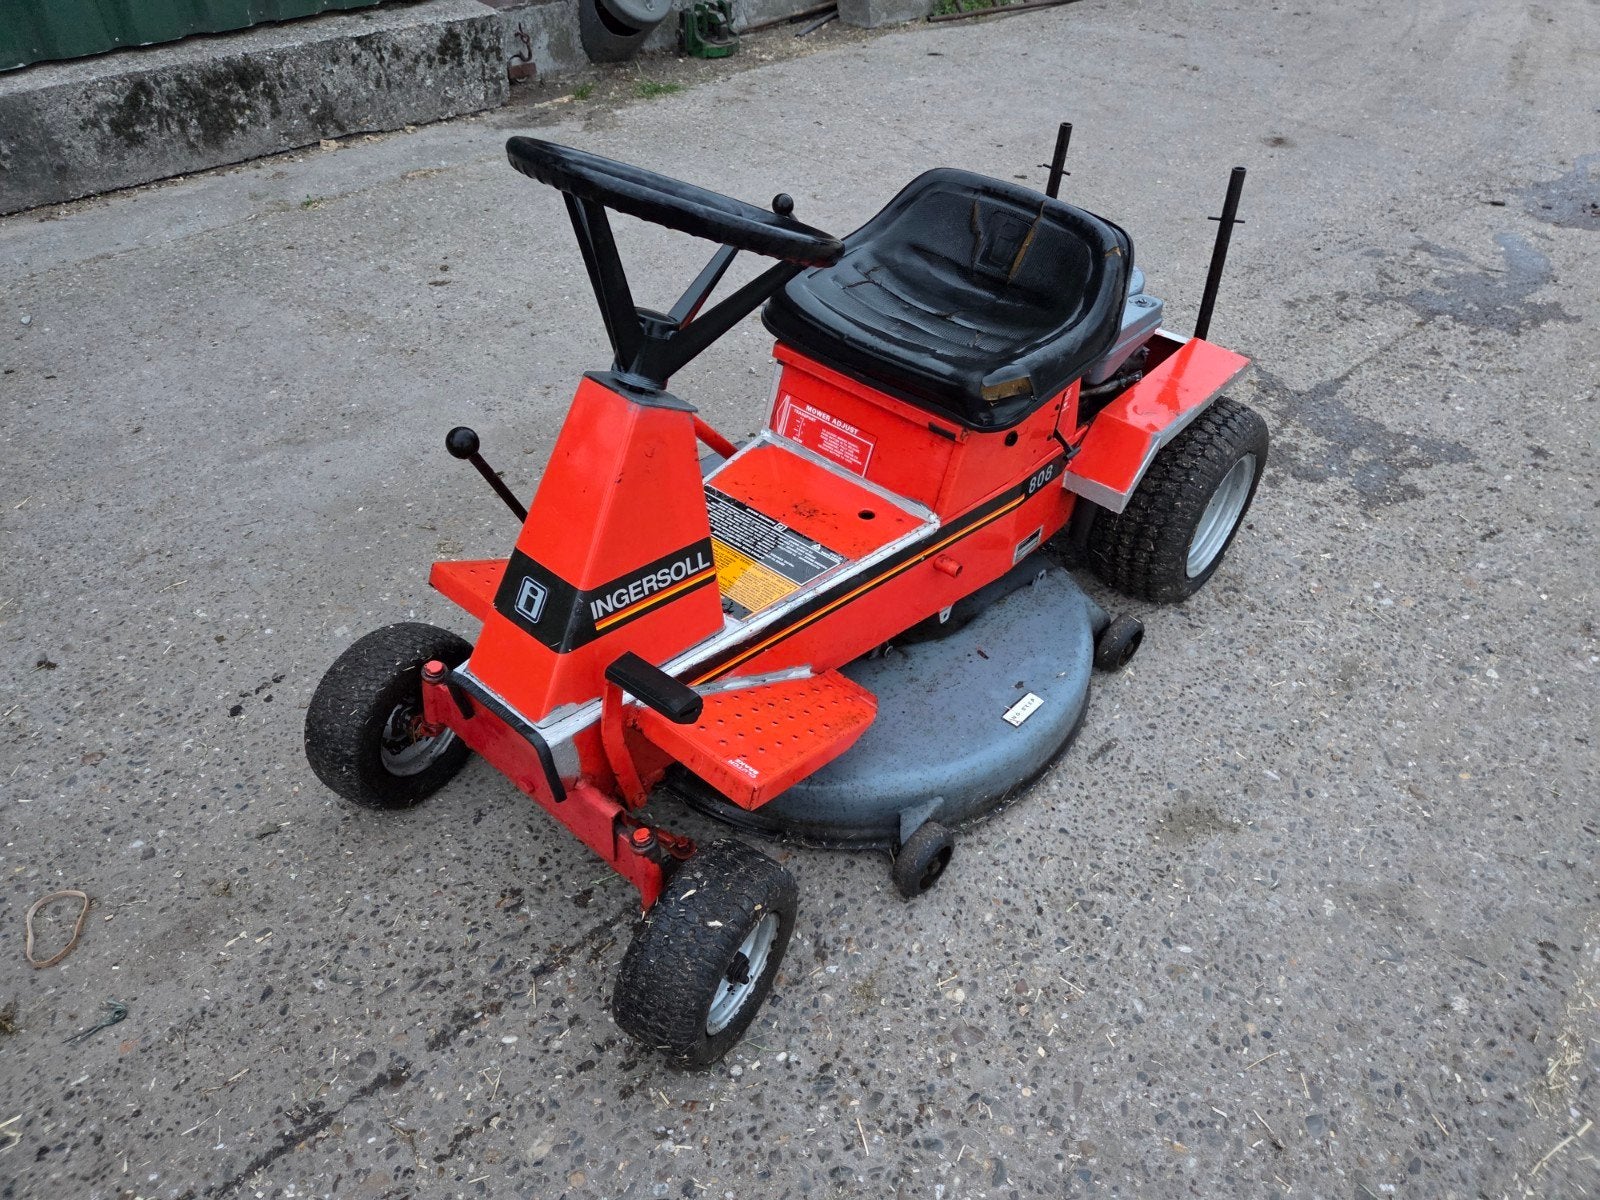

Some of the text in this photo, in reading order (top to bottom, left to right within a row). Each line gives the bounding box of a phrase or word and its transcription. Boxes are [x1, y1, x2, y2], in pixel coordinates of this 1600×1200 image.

[805, 404, 860, 435] MOWER ADJUST
[1028, 464, 1054, 494] 808
[589, 552, 711, 620] INGERSOLL
